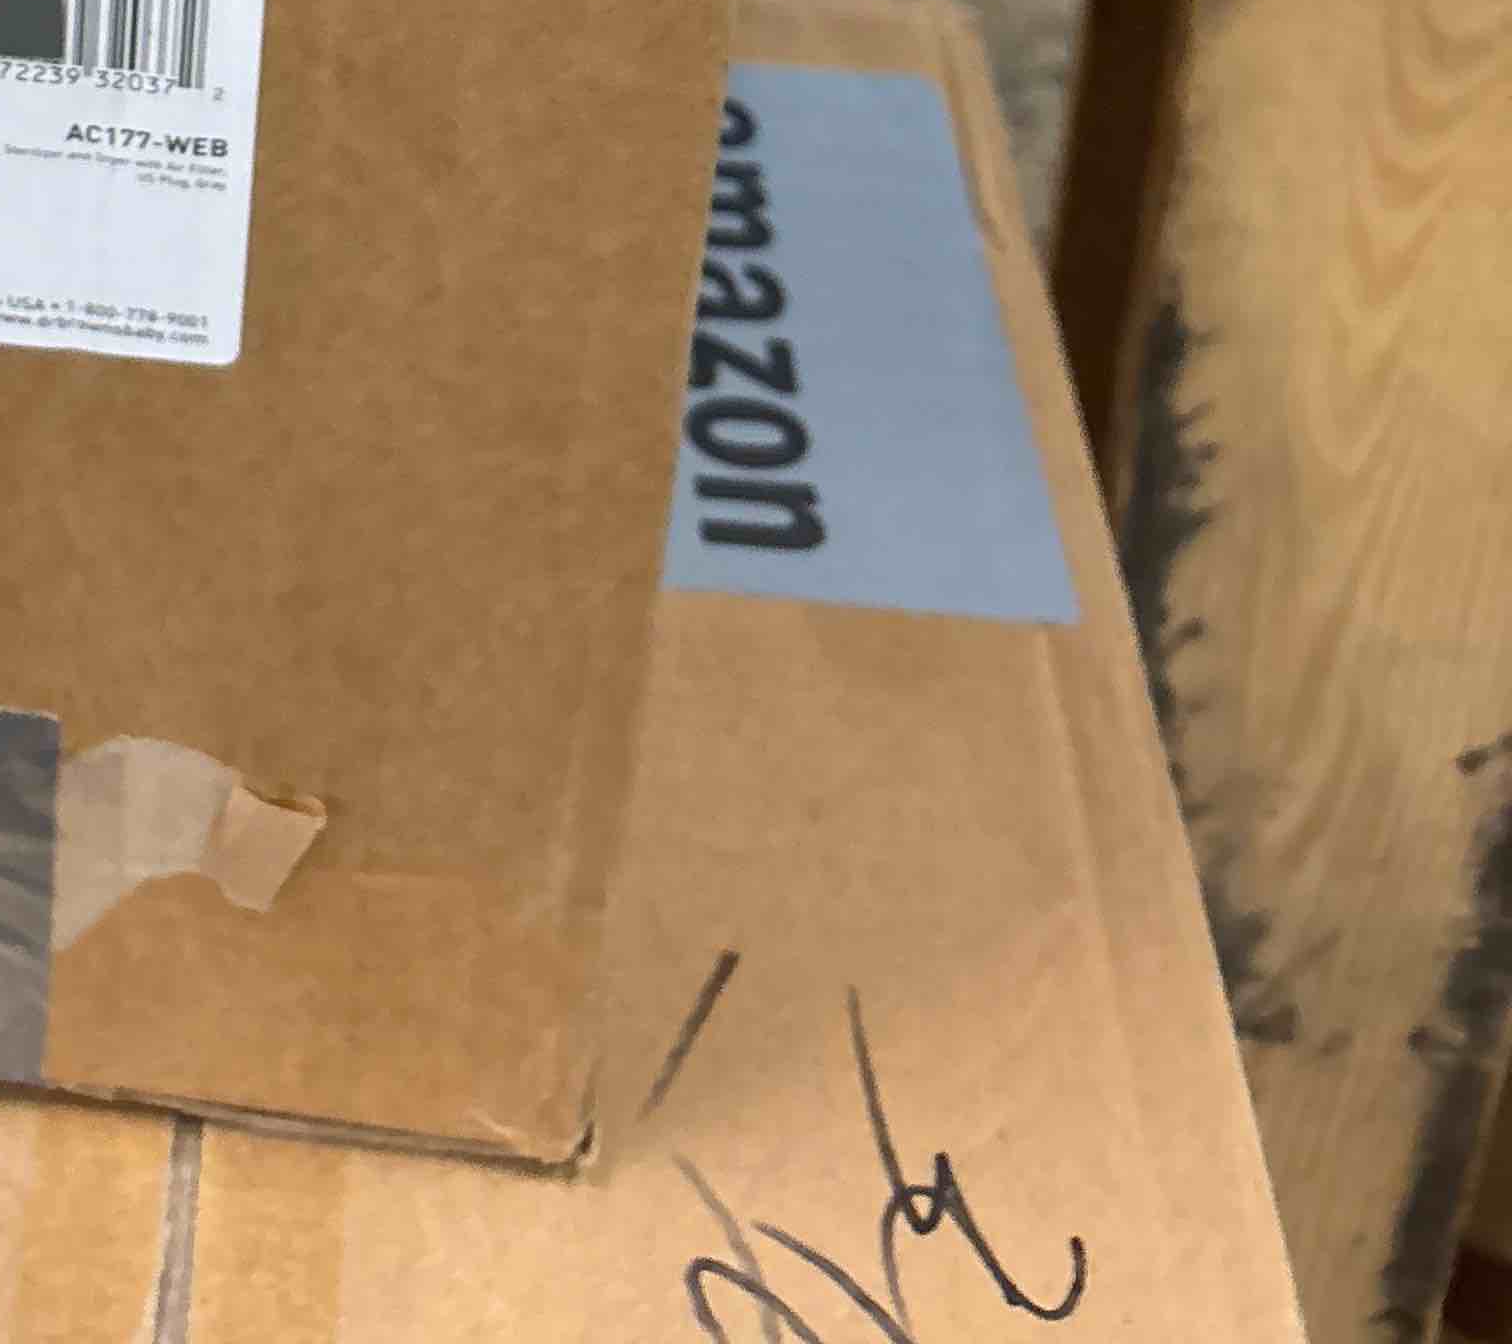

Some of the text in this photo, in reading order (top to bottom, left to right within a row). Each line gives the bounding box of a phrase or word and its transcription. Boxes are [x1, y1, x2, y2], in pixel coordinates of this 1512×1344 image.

[0, 61, 81, 85] 72239
[95, 69, 177, 94] 32037
[212, 87, 225, 101] 2
[65, 123, 229, 158] AC177-WEB
[7, 294, 45, 311] USA
